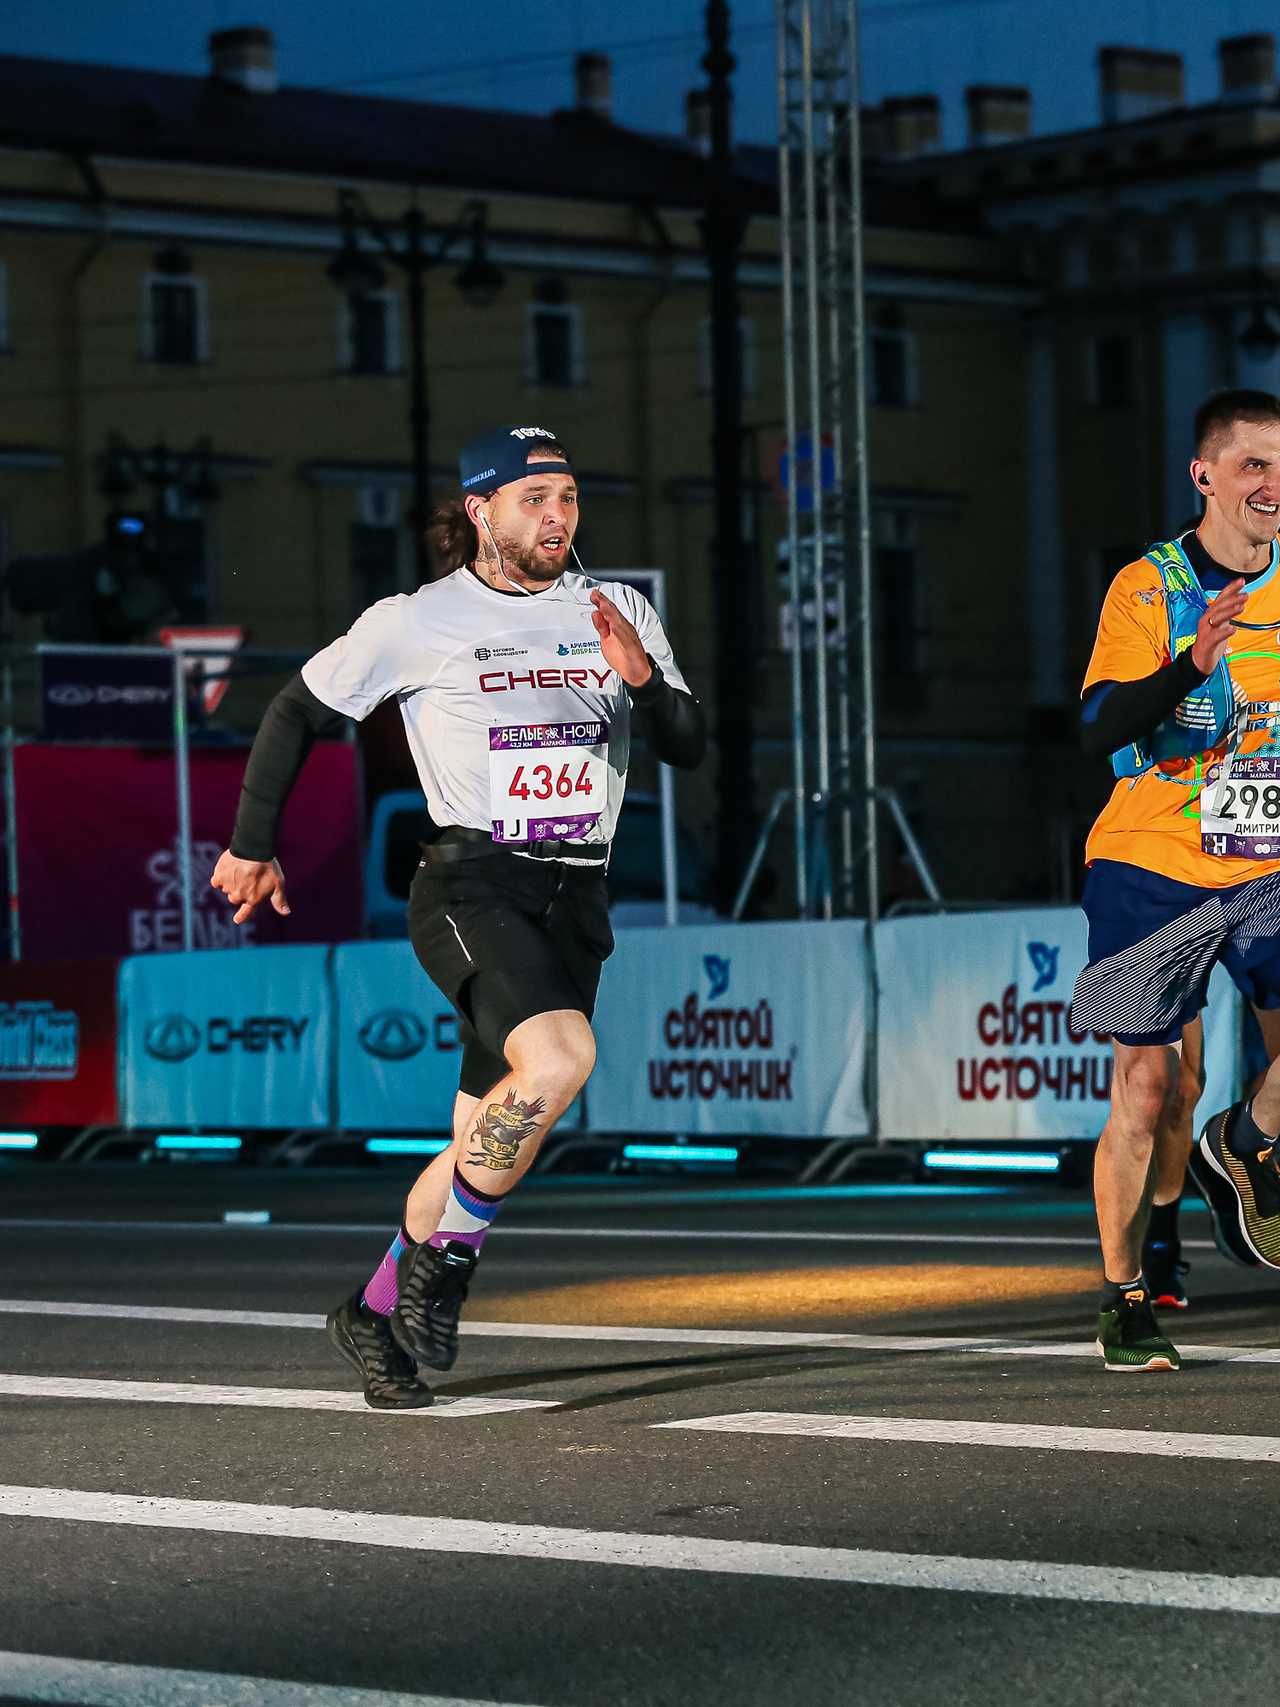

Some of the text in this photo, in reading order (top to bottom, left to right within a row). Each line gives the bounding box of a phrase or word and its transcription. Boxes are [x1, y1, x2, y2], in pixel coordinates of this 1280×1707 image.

[571, 648, 593, 656] ДОБРА
[479, 668, 613, 693] CHERY
[502, 723, 601, 742] БЕЛЫЕ НОЧИ
[508, 761, 593, 801] 4364
[509, 819, 520, 838] J
[207, 1016, 309, 1053] CHERY
[664, 992, 773, 1048] святой
[648, 1059, 793, 1100] источник
[956, 1056, 1114, 1100] источни
